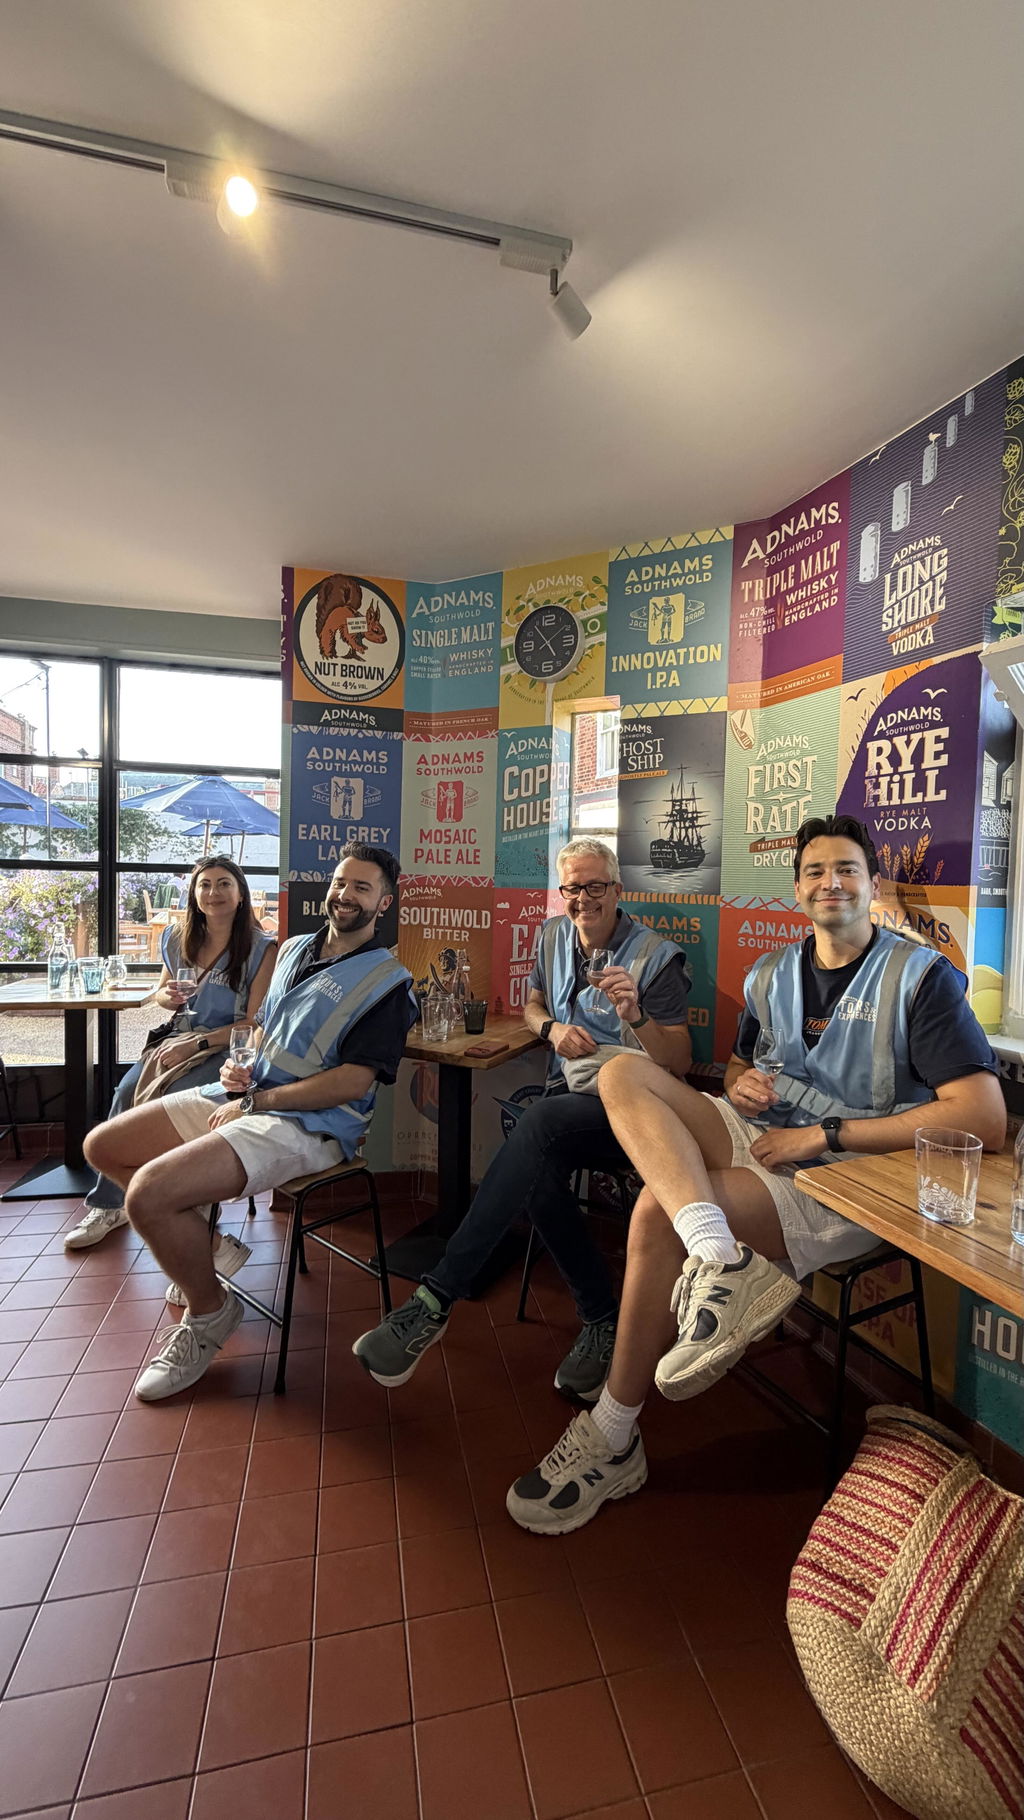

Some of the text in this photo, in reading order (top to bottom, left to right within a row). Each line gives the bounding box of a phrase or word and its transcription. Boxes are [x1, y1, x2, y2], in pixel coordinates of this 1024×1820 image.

[740, 502, 842, 568] ADNAMS.
[764, 530, 824, 568] SOUTHWOLD
[891, 536, 942, 568] ADNAMS.
[900, 548, 932, 566] SOUTHWOLD
[625, 554, 713, 584] ADNAMS
[741, 540, 840, 603] TRIPLE MALT
[525, 575, 585, 599] ADNAMS.
[624, 572, 712, 596] SOUTHWOLD
[786, 571, 839, 606] WHISKY
[884, 548, 948, 612] LONG
[411, 590, 496, 618] ADNAMS.
[784, 588, 839, 616] HANDCRAFTED IN
[882, 570, 948, 632] SHORE
[428, 609, 480, 624] SOUTHWOLD
[542, 614, 556, 627] 12
[629, 607, 706, 628] JACK BRAND
[750, 606, 768, 618] 47%
[784, 596, 838, 626] ENGLAND
[739, 616, 776, 630] NON-CHILL
[739, 624, 776, 638] FILTERED
[895, 618, 930, 639] TRIPLE MALT
[412, 622, 495, 649] SINGLE MALT
[562, 634, 575, 647] 3
[892, 626, 934, 656] VODKA
[449, 648, 494, 662] WHISKY
[522, 640, 534, 653] 9
[542, 660, 554, 672] 6
[612, 644, 722, 672] INNOVATION
[314, 661, 338, 677] NUT
[341, 664, 384, 681] BROWN
[448, 665, 494, 678] ENGLAND
[647, 670, 680, 690] I.P.A
[342, 680, 357, 690] 4%
[741, 688, 775, 699] MATURED
[784, 676, 816, 690] AMERICAN
[816, 672, 830, 680] OAK
[320, 709, 378, 728] ADNAMS.
[331, 720, 368, 728] SOUTHWOLD
[873, 706, 944, 736] ADNAMS.
[620, 724, 654, 734] DNAMS.
[885, 722, 930, 736] SOUTHWOLD
[306, 746, 388, 764] ADNAMS
[416, 750, 484, 766] ADNAMS
[517, 752, 552, 761] SOUTHWO
[620, 738, 664, 759] HOST
[864, 726, 950, 778] RYE
[306, 761, 388, 774] SOUTHWOLD
[416, 766, 484, 776] SOUTHWOLD
[628, 754, 664, 772] SHIP
[504, 762, 570, 802] COPPER
[746, 755, 818, 798] FIRST
[312, 792, 330, 803] JACK
[503, 796, 558, 832] HOUSE
[744, 794, 813, 834] RATE
[880, 807, 927, 818] RYE MALT
[298, 824, 391, 843] EARL GREY
[874, 816, 932, 832] VODKA
[419, 828, 477, 845] MOSAIC
[757, 840, 779, 850] TRIPLE
[414, 848, 480, 865] PALE ALE
[753, 852, 780, 868] DRY
[401, 886, 443, 900] ADNAMS.
[400, 906, 491, 929] SOUTHWOLD
[423, 928, 470, 942] BITTER
[738, 920, 814, 940] ADNAMS
[870, 909, 954, 949] DNAMS.
[510, 963, 532, 976] SINGLE
